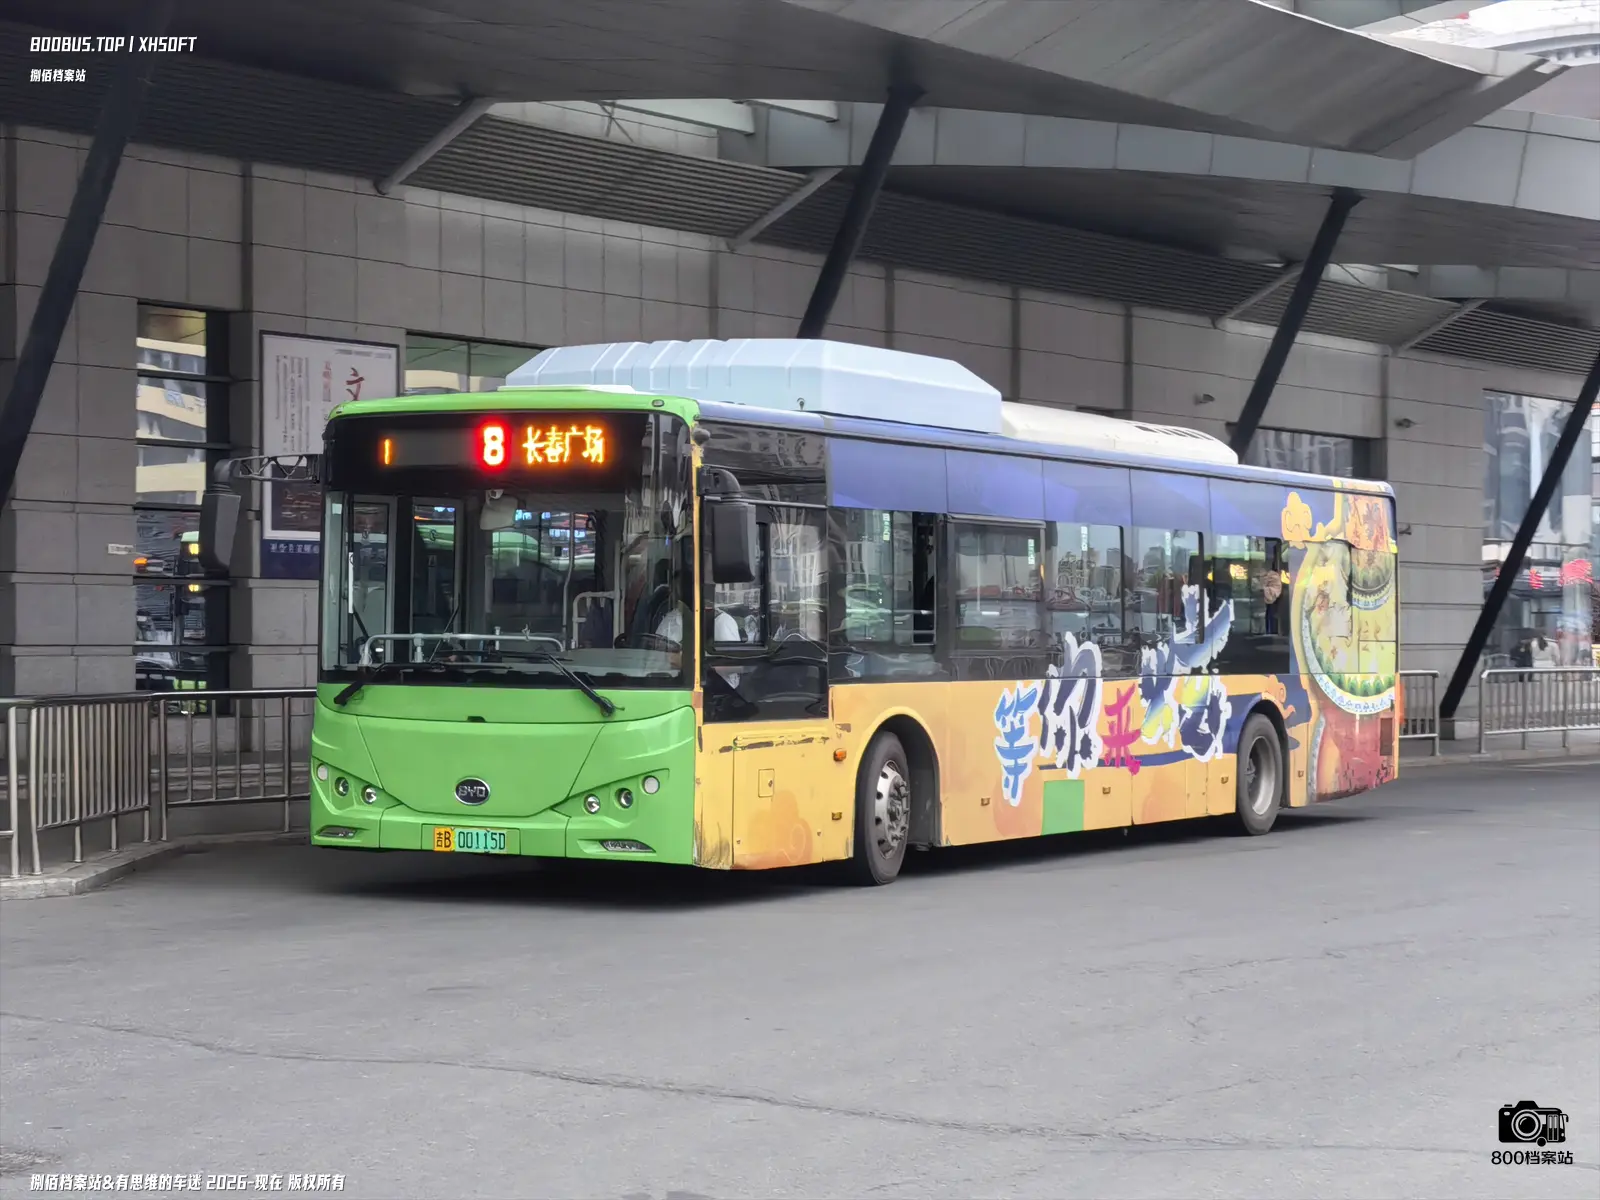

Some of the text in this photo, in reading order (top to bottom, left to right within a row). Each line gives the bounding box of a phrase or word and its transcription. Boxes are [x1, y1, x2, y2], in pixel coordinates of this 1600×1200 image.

[482, 425, 504, 466] 8
[521, 425, 606, 465] 长春广场
[458, 785, 486, 798] BYD
[436, 830, 506, 850] 吉B 00115D
